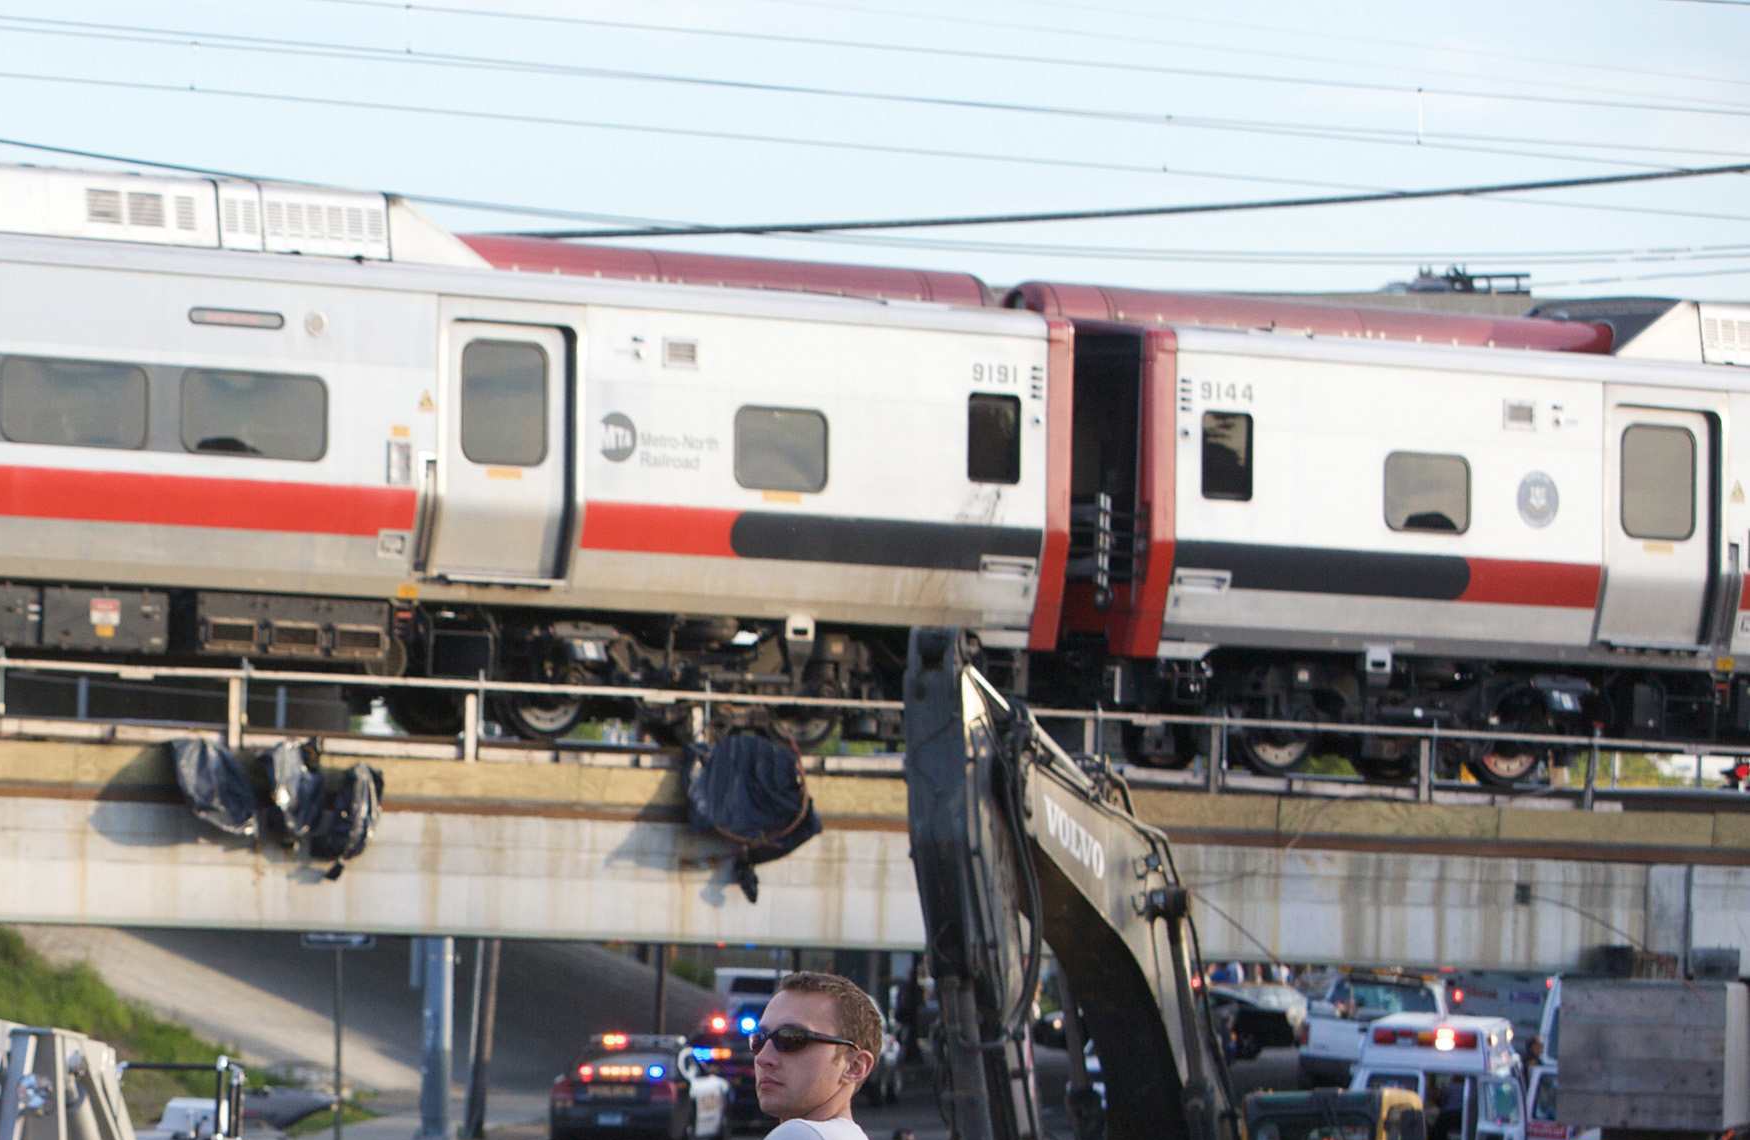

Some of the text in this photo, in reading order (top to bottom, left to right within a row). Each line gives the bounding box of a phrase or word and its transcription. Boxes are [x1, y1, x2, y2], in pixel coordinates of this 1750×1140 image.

[972, 363, 1019, 384] 9191
[1200, 382, 1254, 402] 9144
[639, 432, 720, 452] Metro-North
[638, 450, 701, 471] Railroad
[1043, 794, 1105, 880] VOLVO
